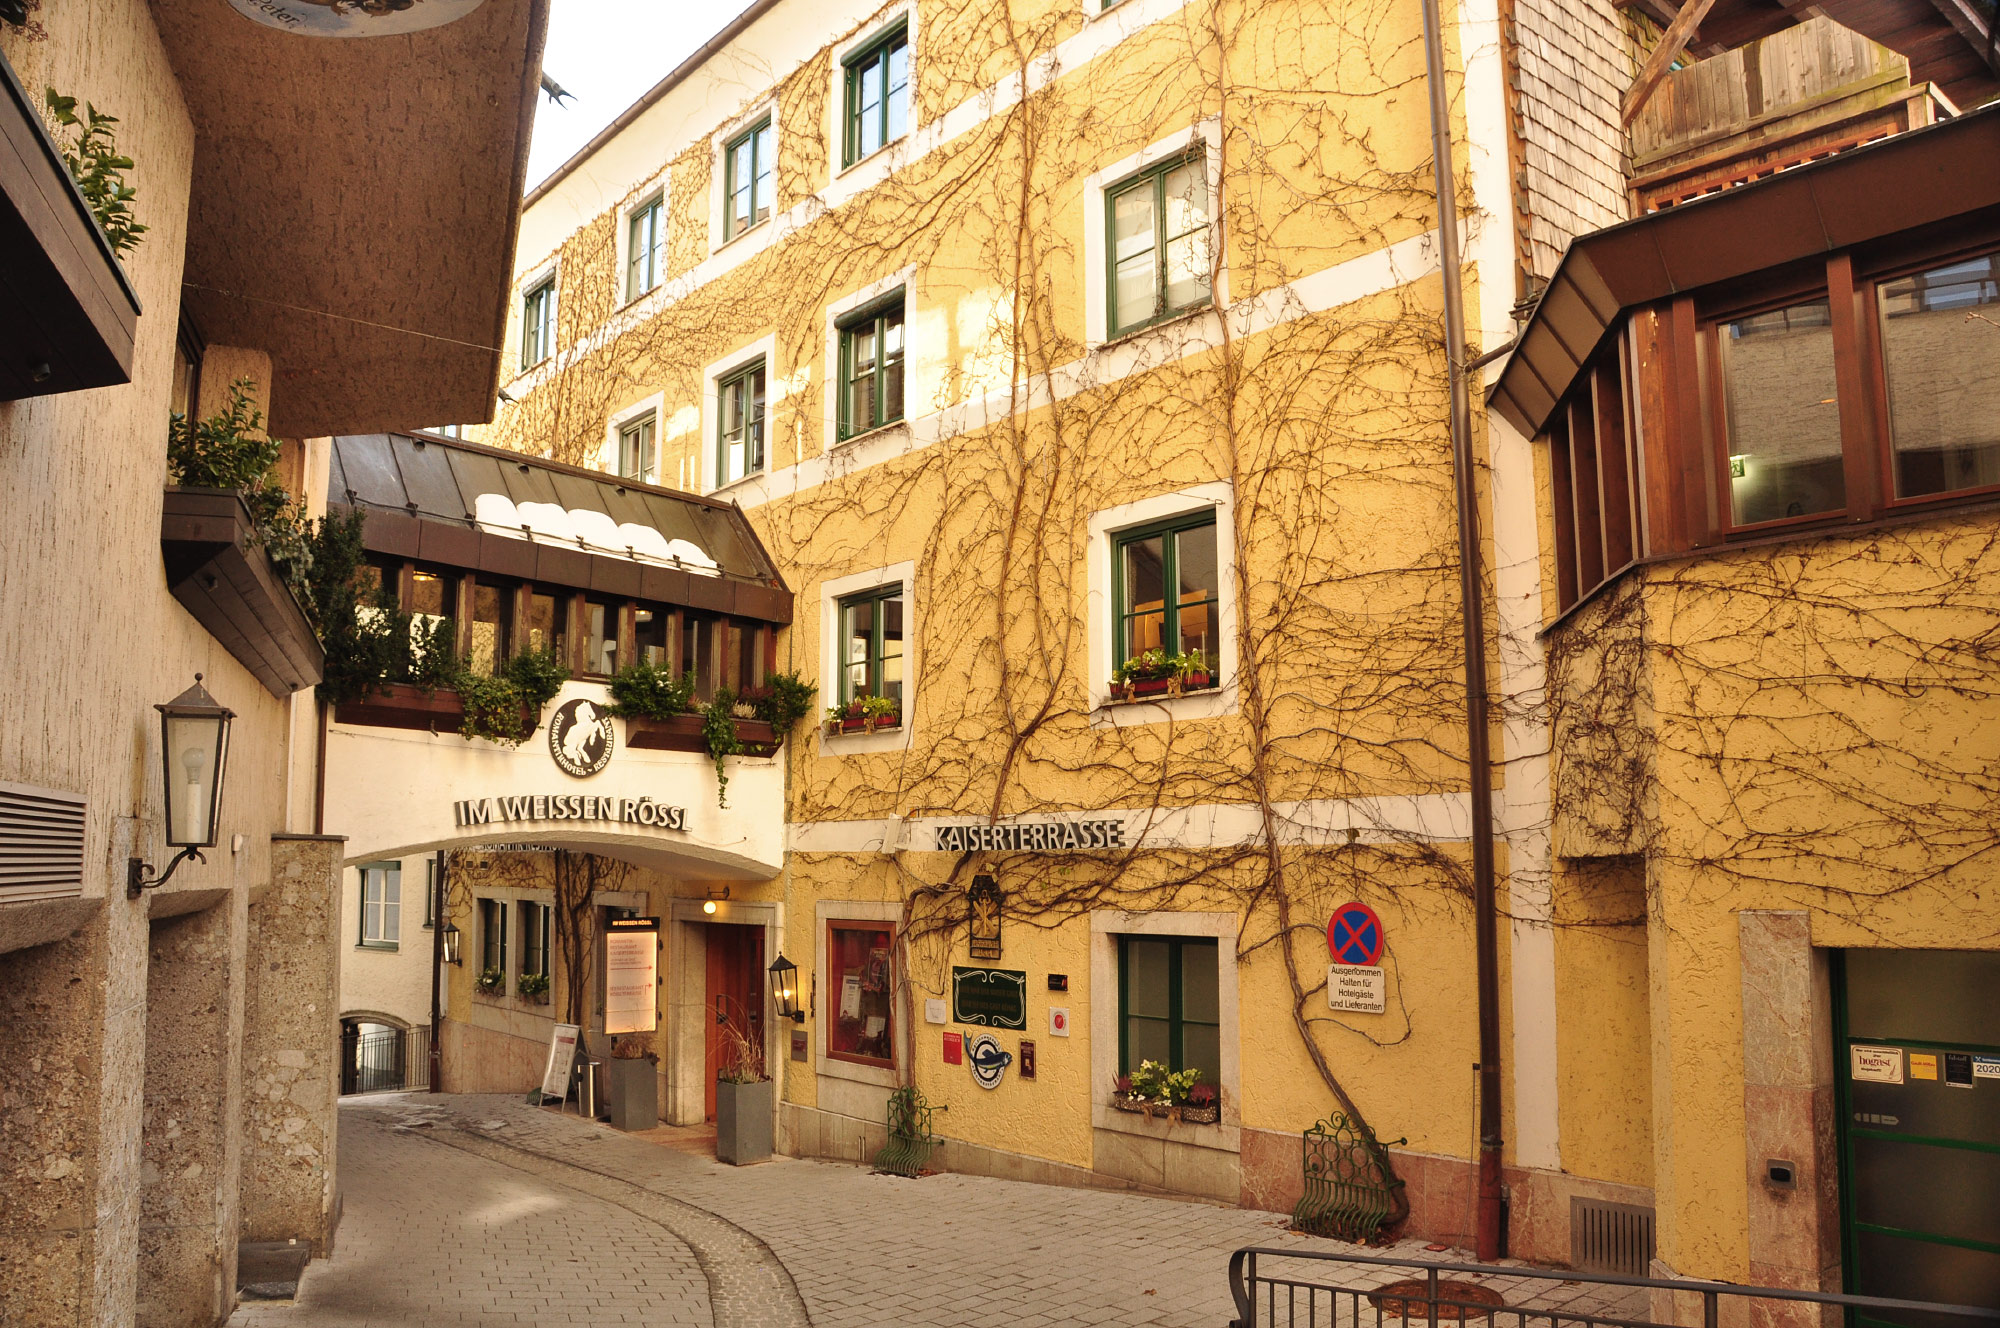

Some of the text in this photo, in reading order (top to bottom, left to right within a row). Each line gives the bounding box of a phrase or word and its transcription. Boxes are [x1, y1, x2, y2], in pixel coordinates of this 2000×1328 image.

[453, 795, 693, 832] IM WEISSEN RÖSSL
[934, 820, 1121, 851] KAISERTERRASSE
[1331, 965, 1382, 977] Ausgenommen
[1340, 977, 1372, 988] Halten für
[1338, 988, 1374, 1000] Hotelgäste
[1331, 1000, 1383, 1011] und Lieferanten
[1859, 1055, 1891, 1068] hogast
[1976, 1065, 2000, 1074] 2020
